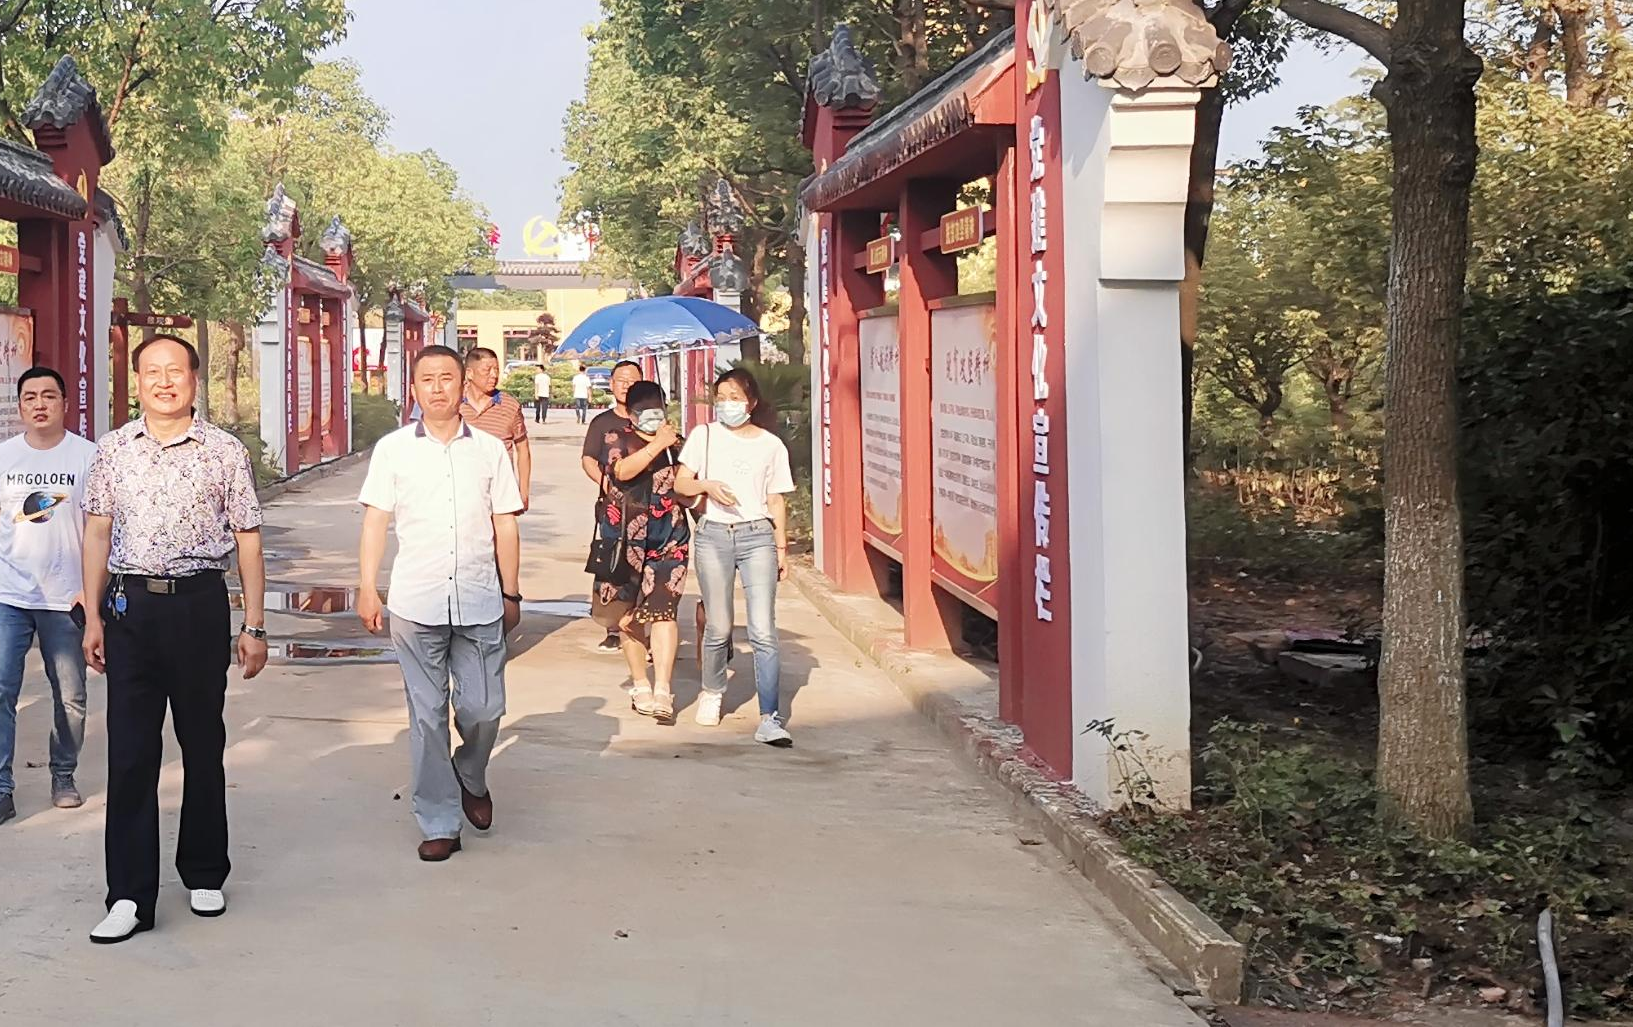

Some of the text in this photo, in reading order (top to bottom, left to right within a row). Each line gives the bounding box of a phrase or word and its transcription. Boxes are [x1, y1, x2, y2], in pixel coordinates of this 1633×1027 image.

[1029, 115, 1053, 622] 党建文化宣传栏
